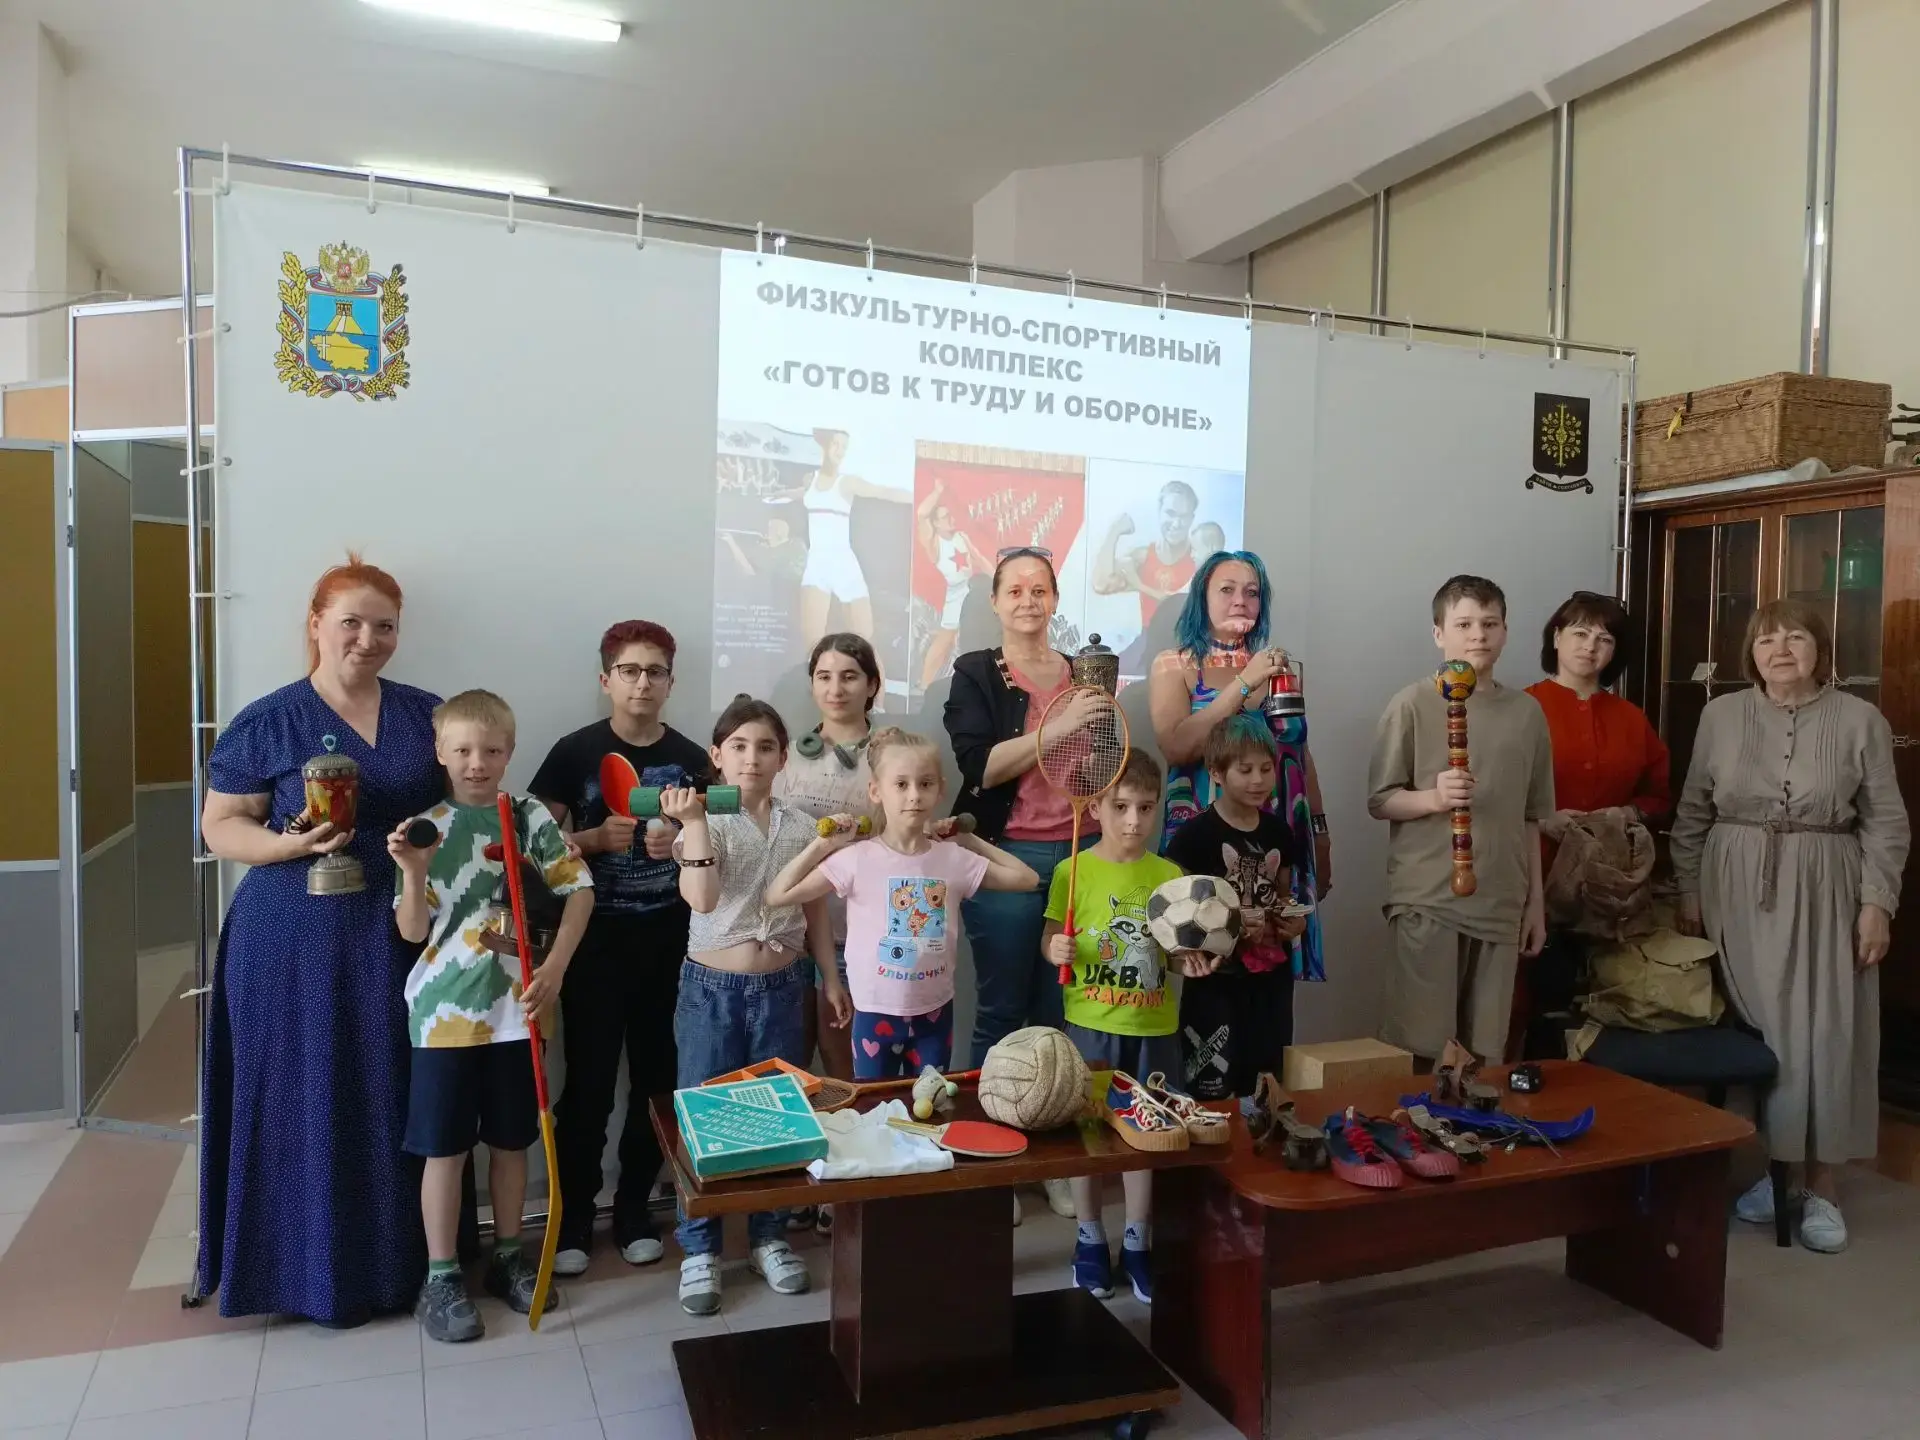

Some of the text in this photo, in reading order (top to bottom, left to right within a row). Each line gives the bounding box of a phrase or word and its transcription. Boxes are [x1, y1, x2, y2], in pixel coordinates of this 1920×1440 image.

[756, 280, 1222, 367] ФИЗКУЛЬТУРНО-СПОРТИВНЫЙ
[919, 341, 1084, 383] КОМПЛЕКС
[763, 360, 1213, 433] «ГОТОВ К ТРУДУ И ОБОРОНЕ»
[1082, 963, 1166, 990] URB
